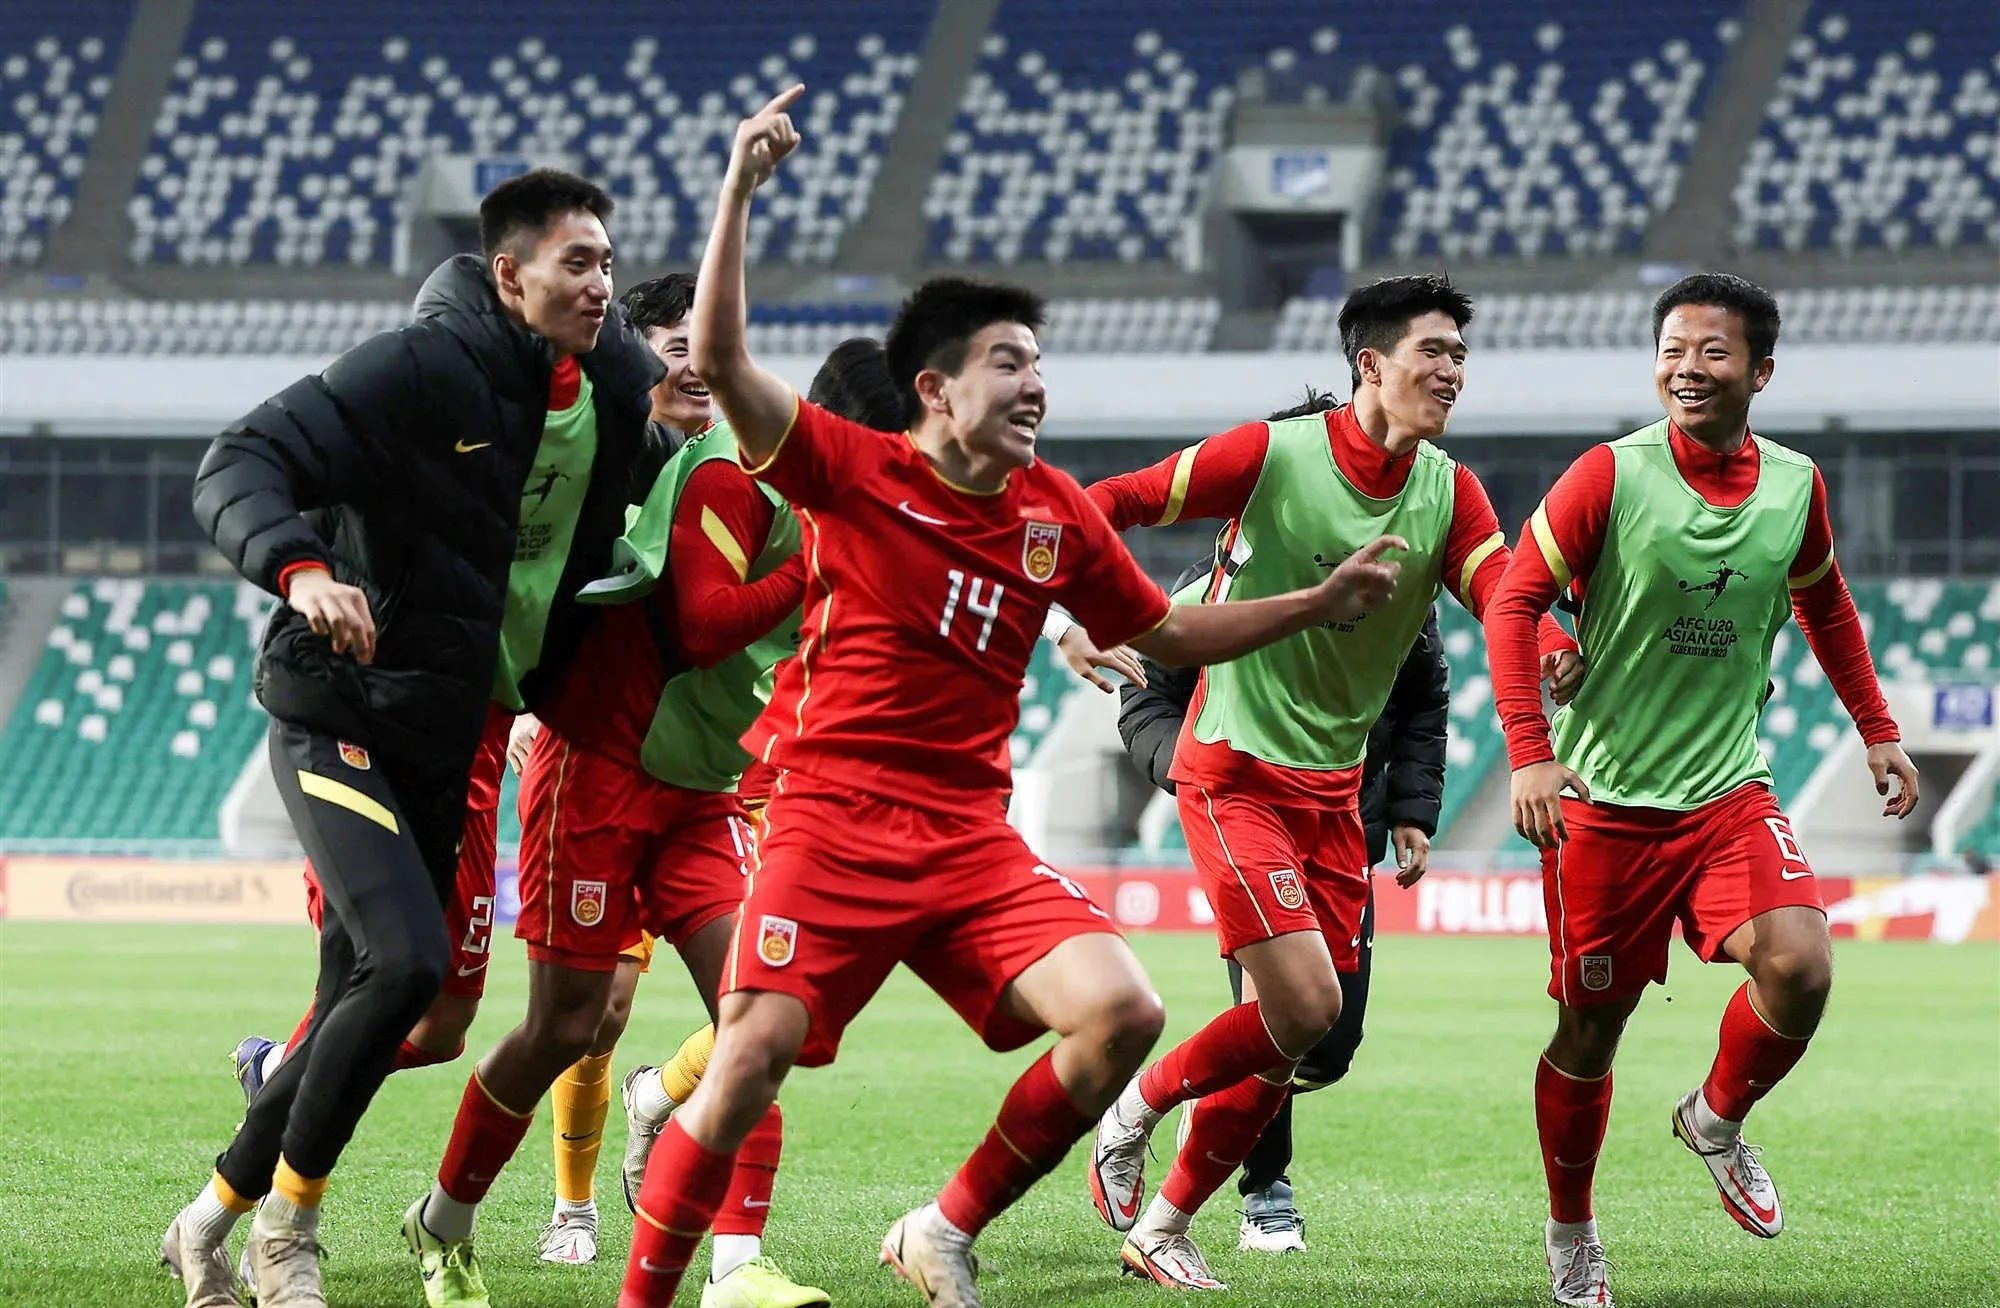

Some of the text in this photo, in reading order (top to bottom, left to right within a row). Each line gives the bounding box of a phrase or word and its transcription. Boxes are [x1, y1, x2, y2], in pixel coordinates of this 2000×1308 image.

[1031, 527, 1057, 540] CFA
[940, 569, 1004, 652] 14
[1673, 616, 1734, 632] AFC U20
[1661, 628, 1738, 646] ASIAN CUP
[1763, 817, 1808, 866] 6
[1273, 873, 1295, 883] CFA
[577, 885, 602, 894] CFA
[1584, 959, 1608, 967] CFA
